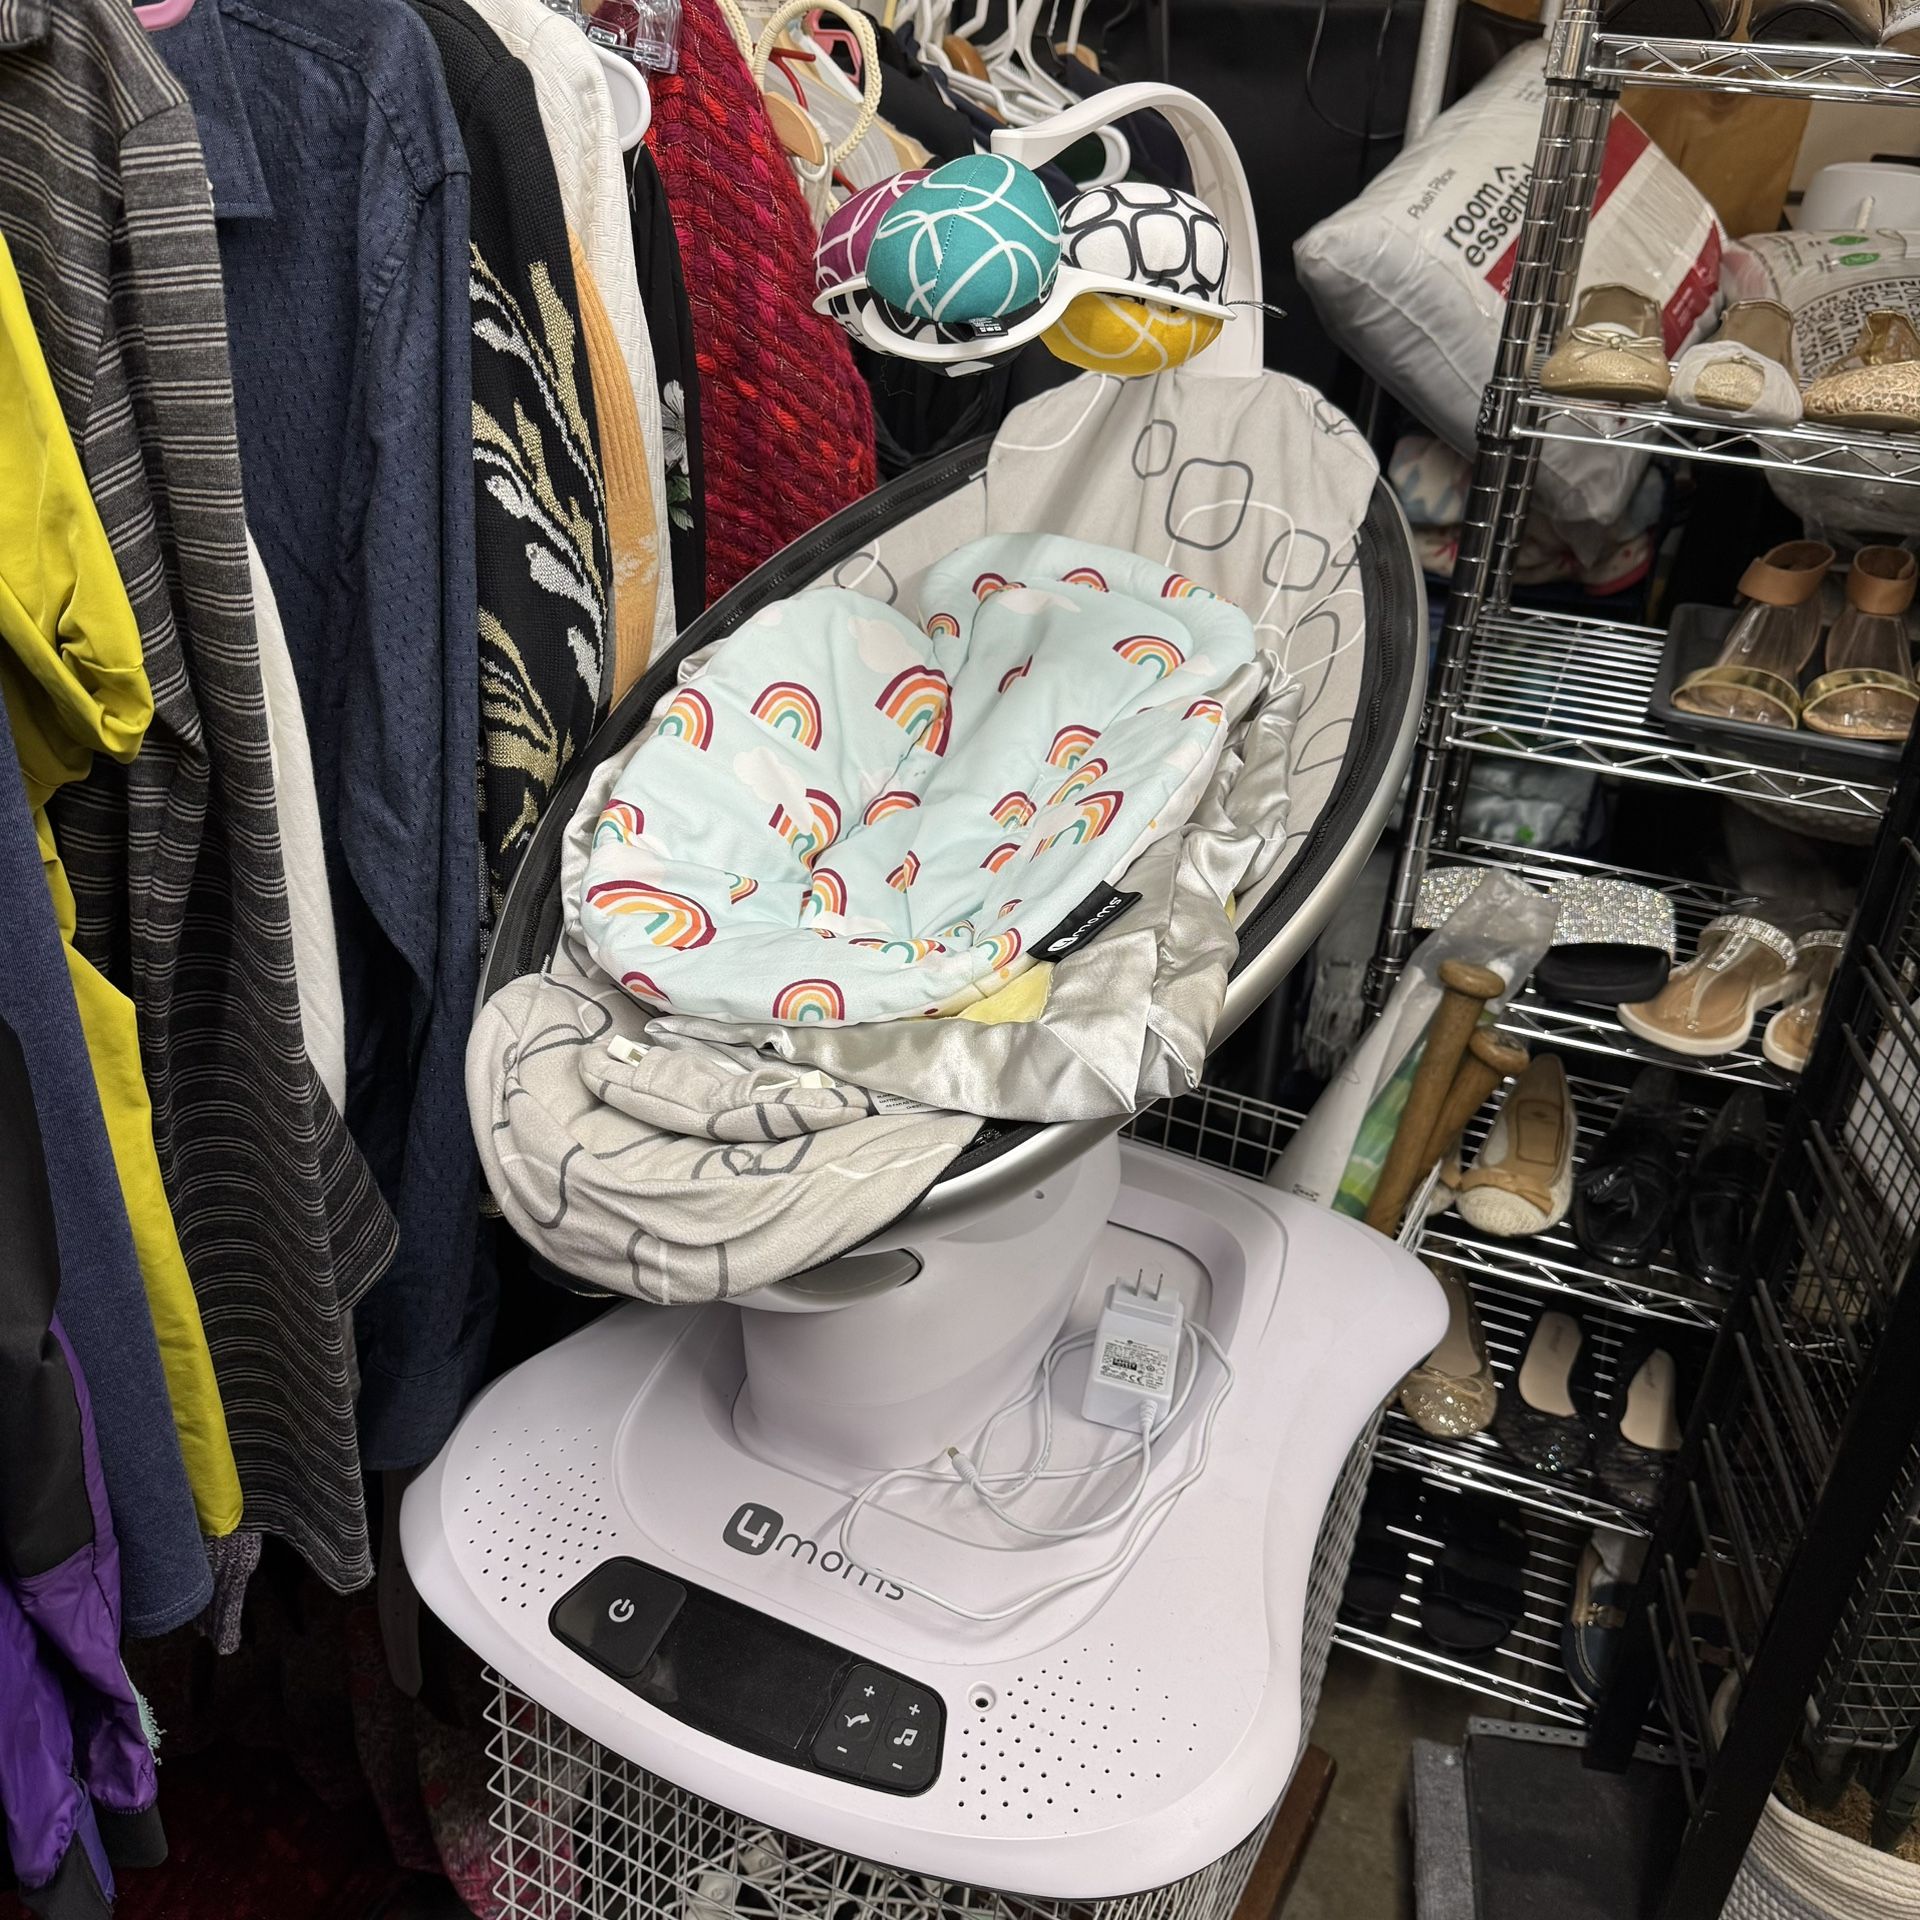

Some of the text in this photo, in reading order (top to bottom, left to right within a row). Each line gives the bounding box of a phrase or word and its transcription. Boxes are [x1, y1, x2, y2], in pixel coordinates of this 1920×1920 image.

[1406, 190, 1438, 220] Plush
[1443, 182, 1504, 249] room
[1464, 162, 1533, 268] essenti
[1046, 896, 1123, 952] 4moms
